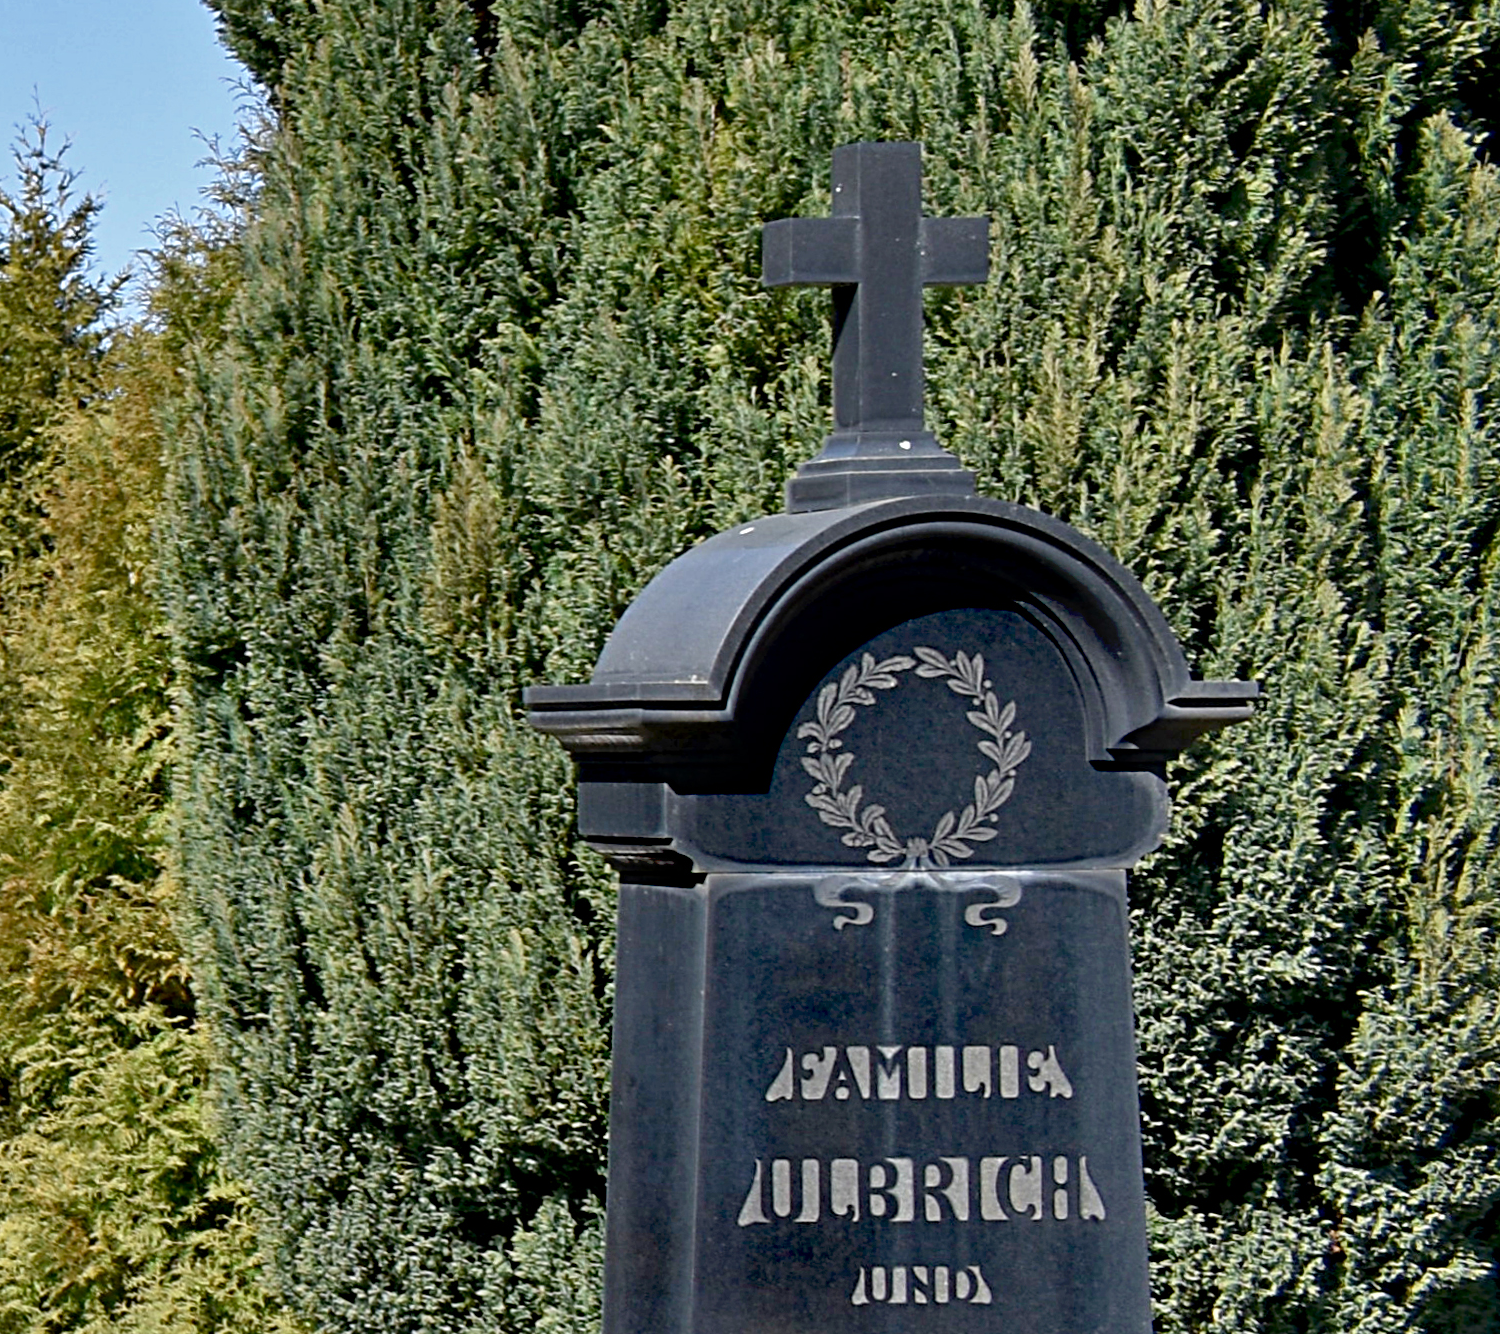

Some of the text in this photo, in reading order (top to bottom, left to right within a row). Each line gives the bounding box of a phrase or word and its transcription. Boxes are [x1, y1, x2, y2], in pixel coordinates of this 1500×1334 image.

[767, 1044, 1074, 1102] FAMILIE
[737, 1155, 1106, 1226] ULBRICH
[851, 1266, 993, 1305] UND
